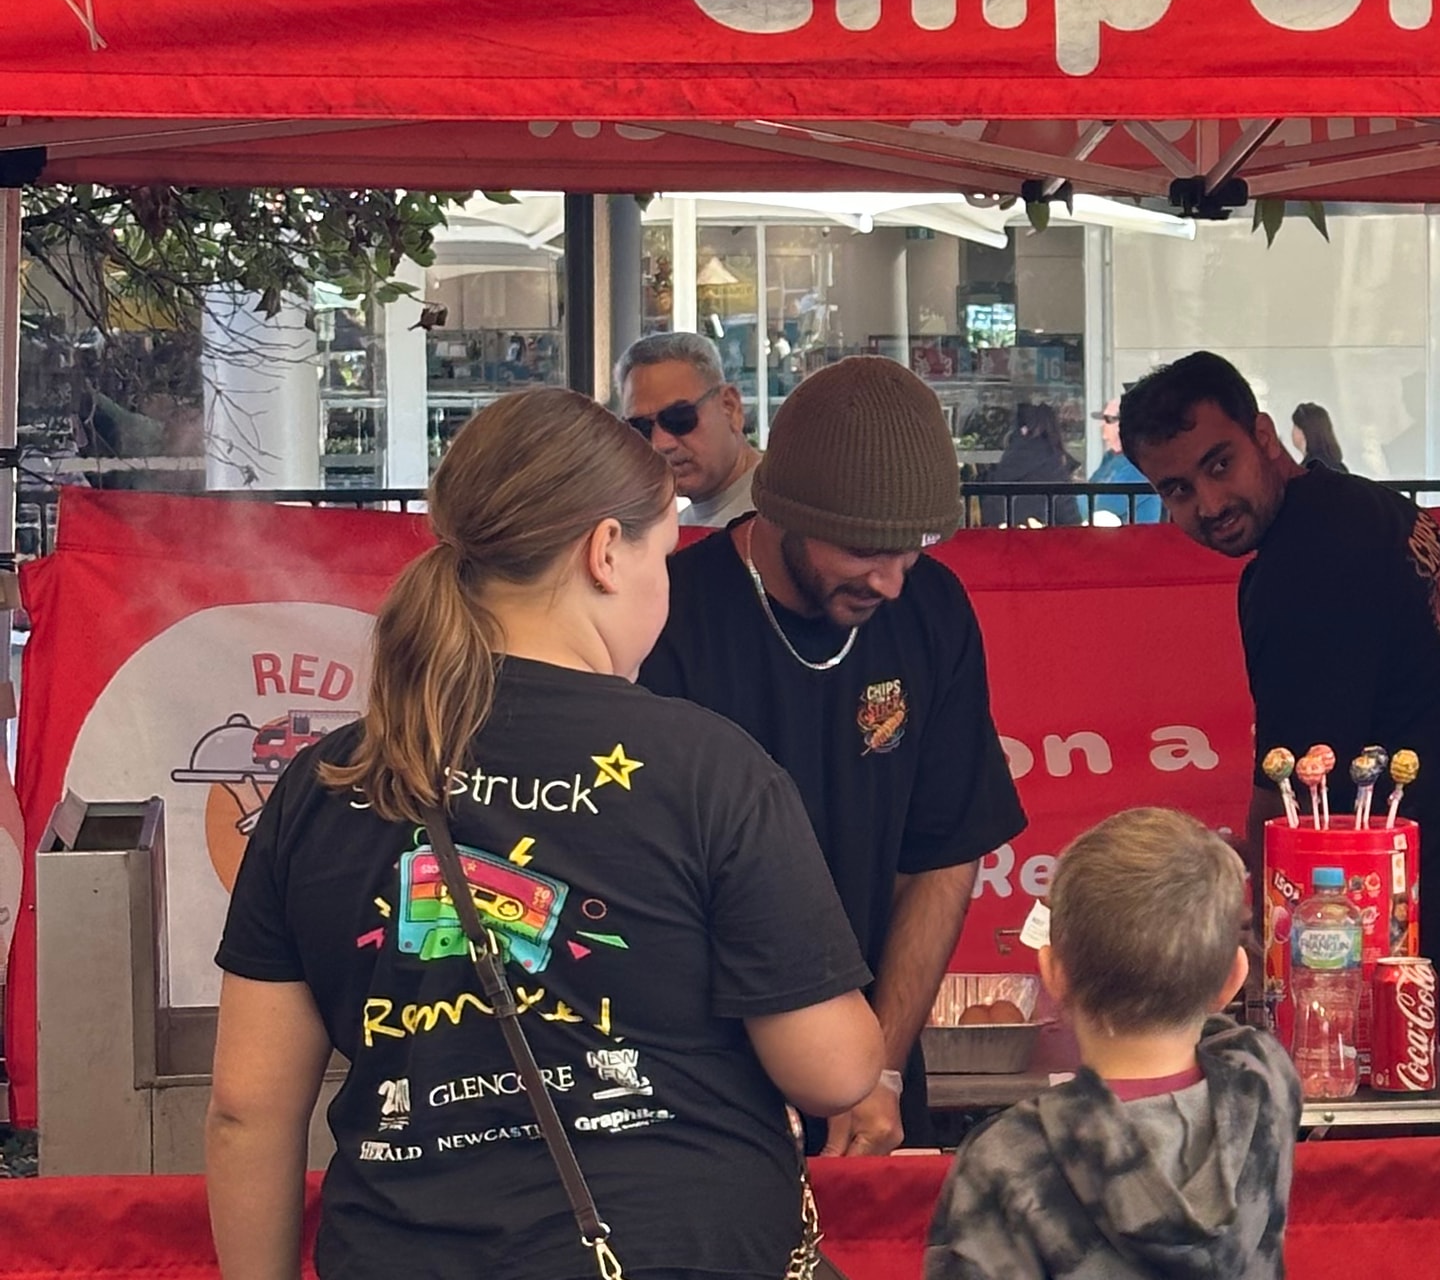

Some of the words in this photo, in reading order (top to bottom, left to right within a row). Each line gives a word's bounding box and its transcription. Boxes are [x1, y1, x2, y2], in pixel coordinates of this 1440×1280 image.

[250, 652, 355, 702] RED
[1149, 724, 1220, 772] a
[971, 842, 1058, 899] Re
